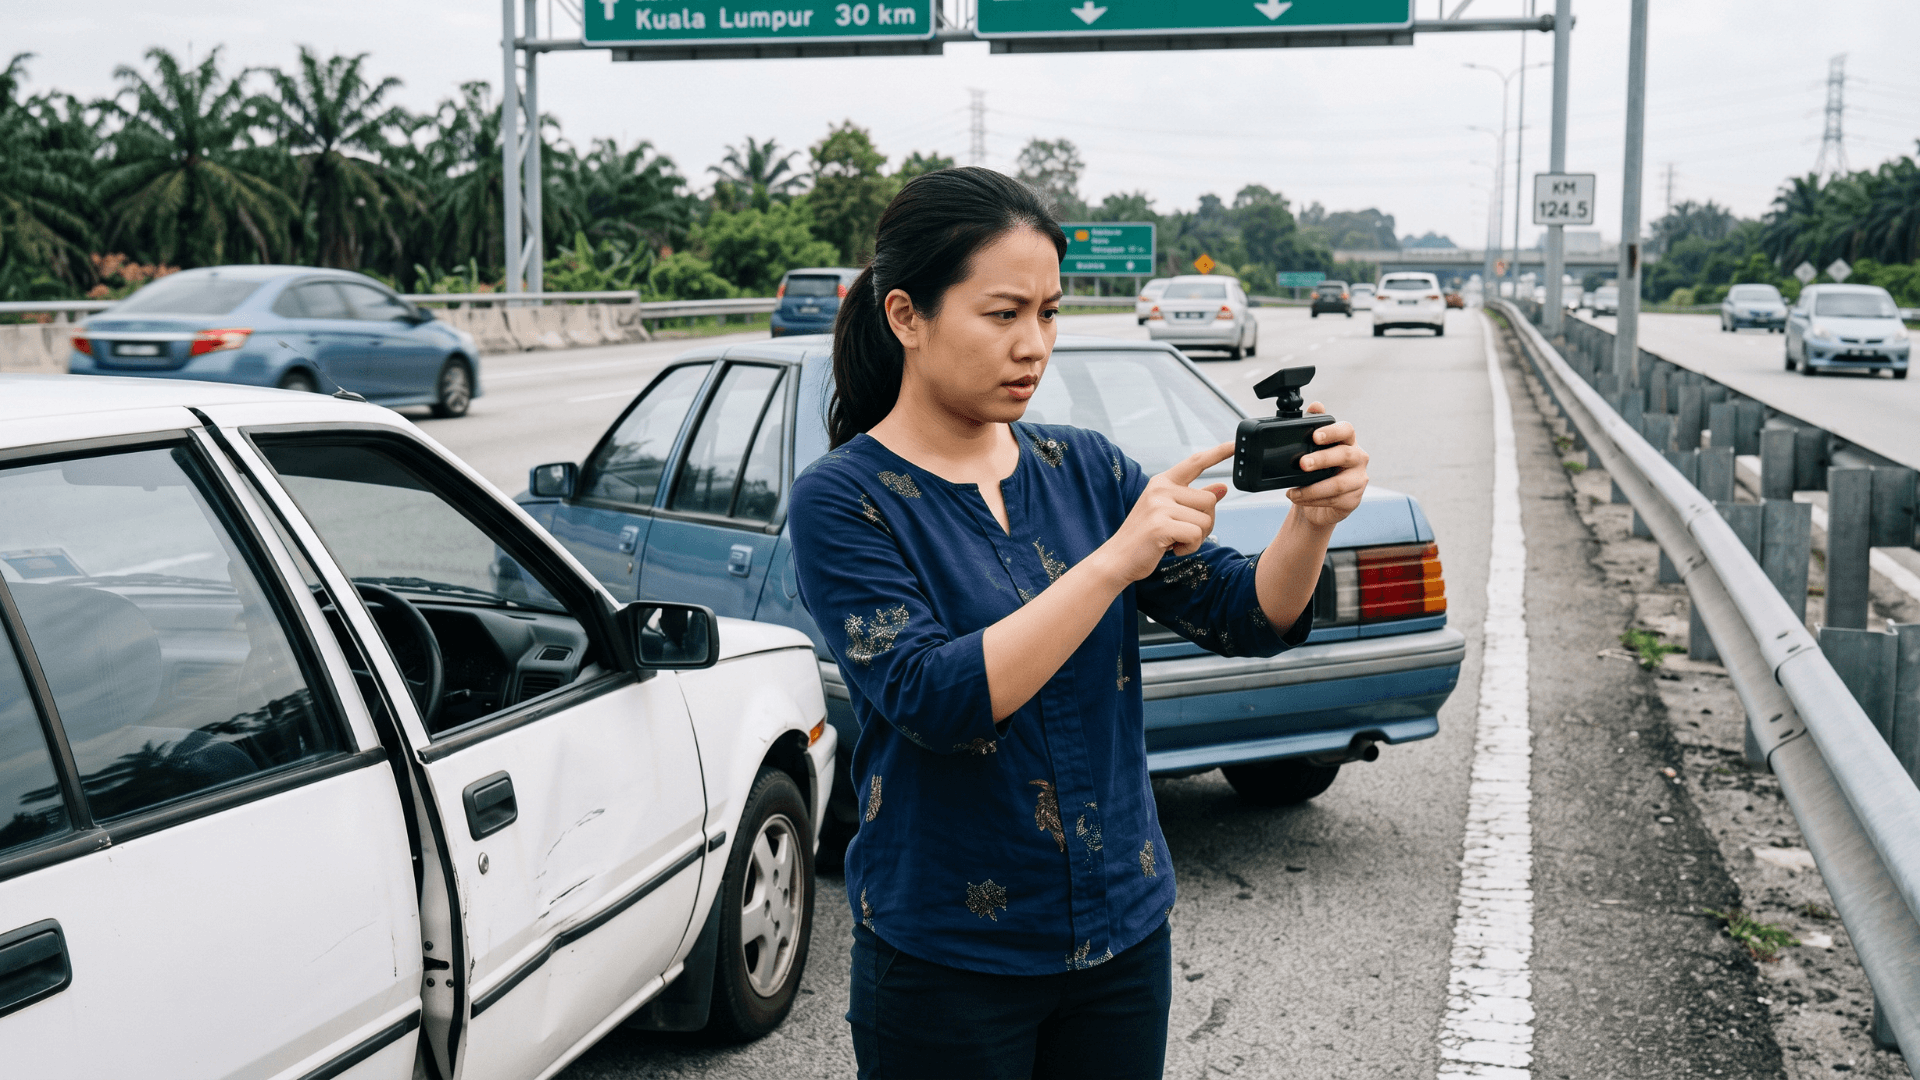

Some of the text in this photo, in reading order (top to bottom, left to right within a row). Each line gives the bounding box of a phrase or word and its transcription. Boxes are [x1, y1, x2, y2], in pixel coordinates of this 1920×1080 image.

[636, 3, 917, 32] Kuala Lumpur 30 km
[1552, 182, 1577, 195] KM
[1540, 201, 1588, 218] 124.5
